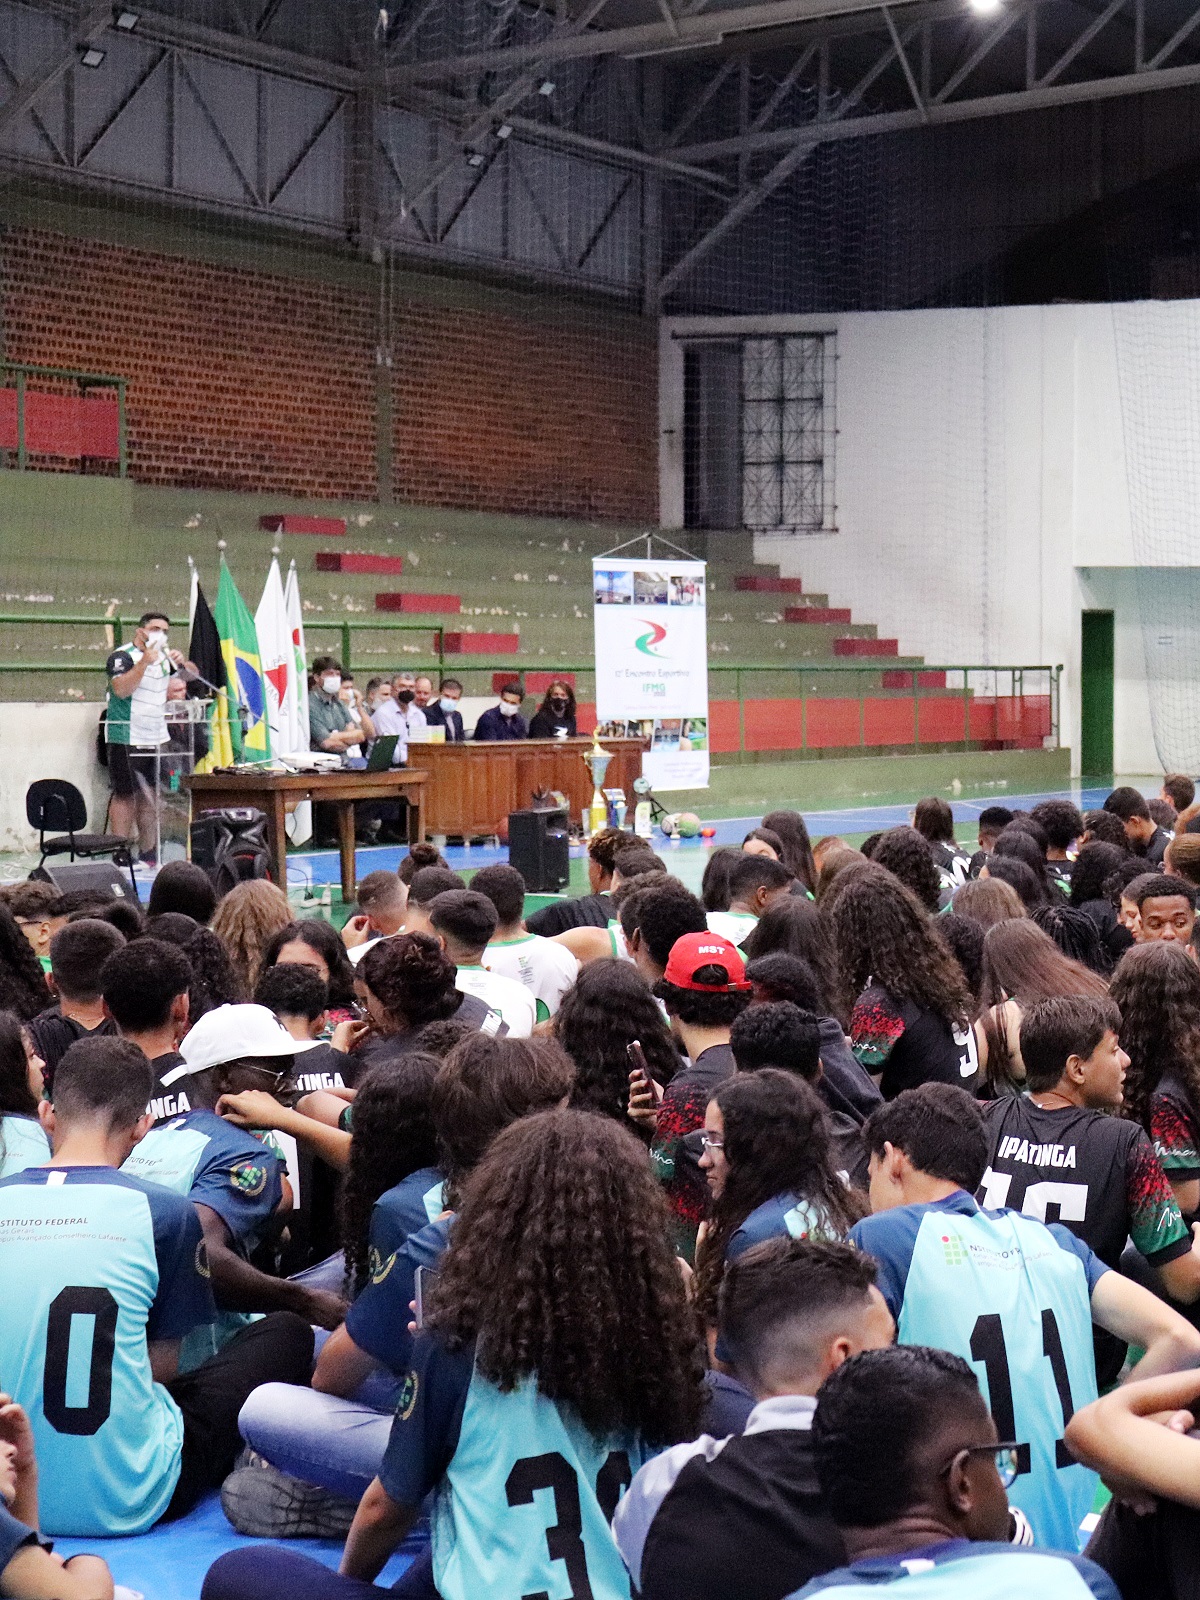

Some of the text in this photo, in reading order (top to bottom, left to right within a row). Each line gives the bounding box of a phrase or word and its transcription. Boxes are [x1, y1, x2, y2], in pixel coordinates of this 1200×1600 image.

[642, 683, 666, 692] IFMG
[698, 945, 726, 955] MST
[997, 1135, 1077, 1169] IPATINGA
[45, 1217, 89, 1227] FEDERAL
[16, 1234, 52, 1242] Avançado
[53, 1232, 97, 1240] Conselheiro
[43, 1285, 119, 1436] 0
[968, 1308, 1081, 1475] 11
